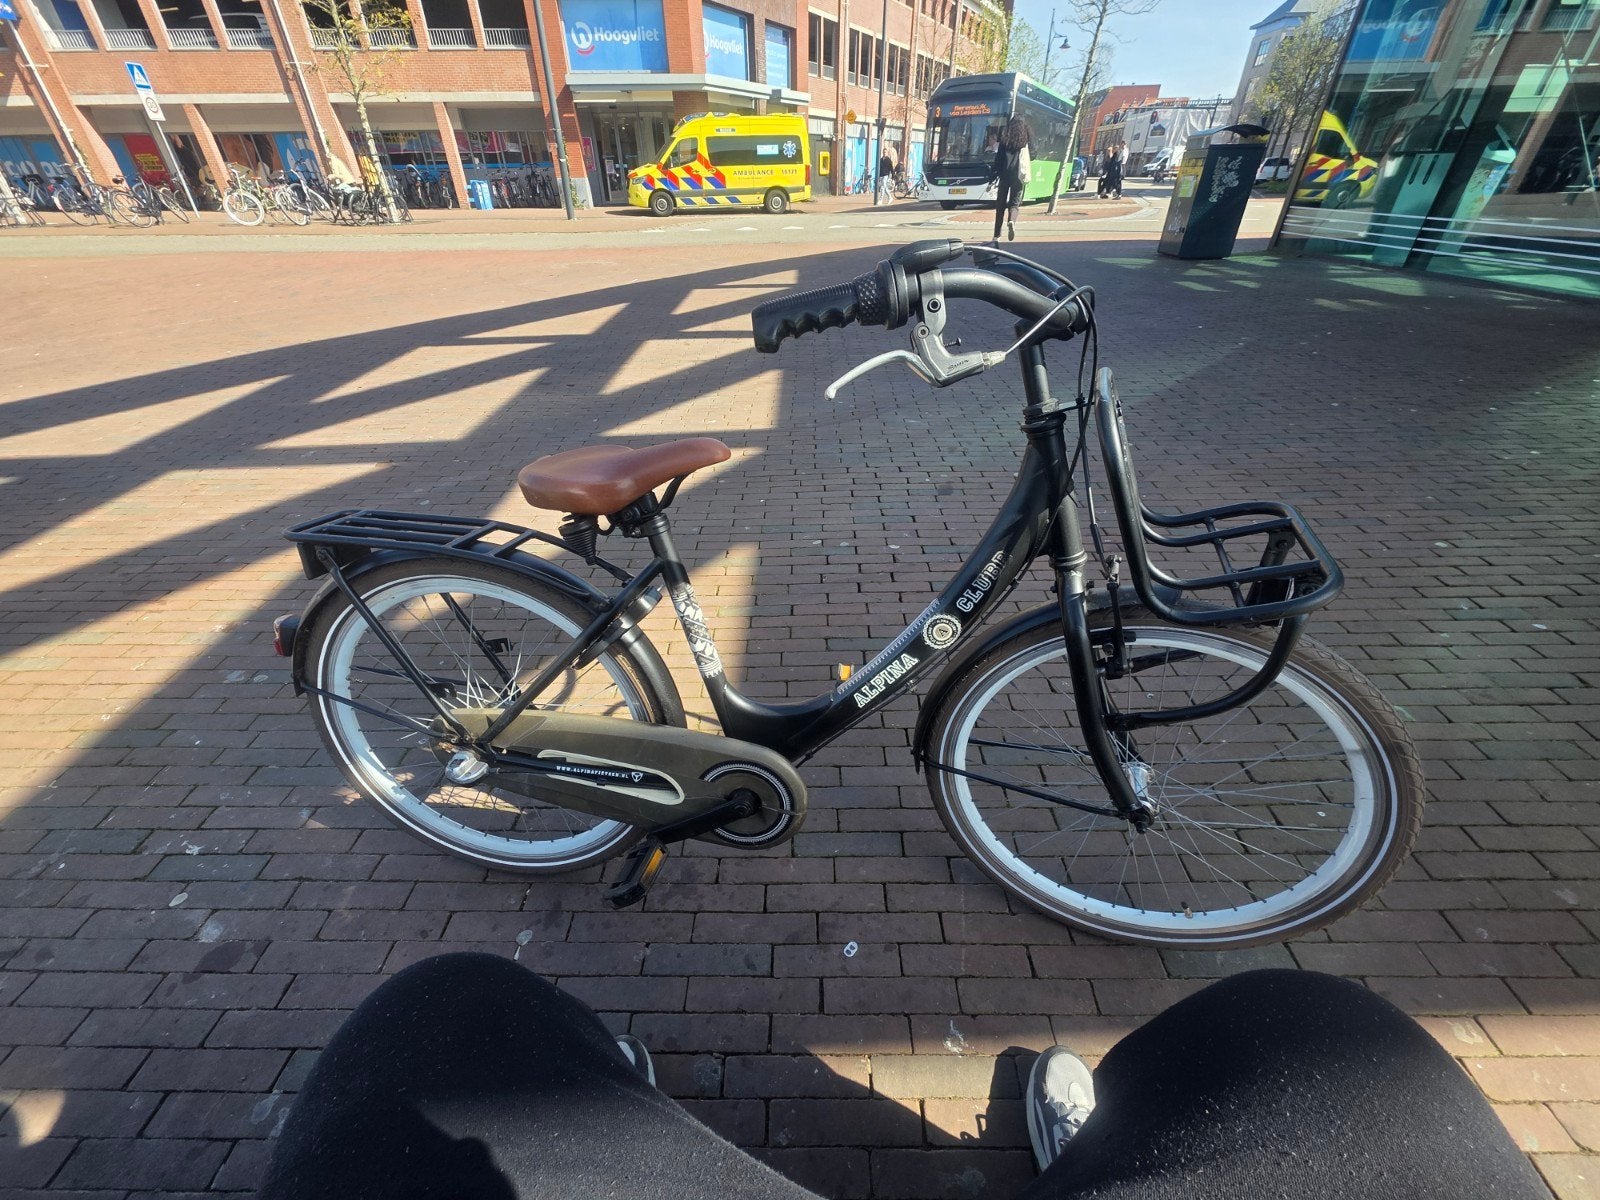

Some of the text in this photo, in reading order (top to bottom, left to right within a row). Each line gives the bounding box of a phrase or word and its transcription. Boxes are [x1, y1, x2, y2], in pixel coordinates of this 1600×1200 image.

[593, 26, 660, 45] Hoogvliet
[709, 32, 744, 56] Hoogvliet
[935, 106, 941, 118] 3
[852, 652, 920, 709] ALPINA
